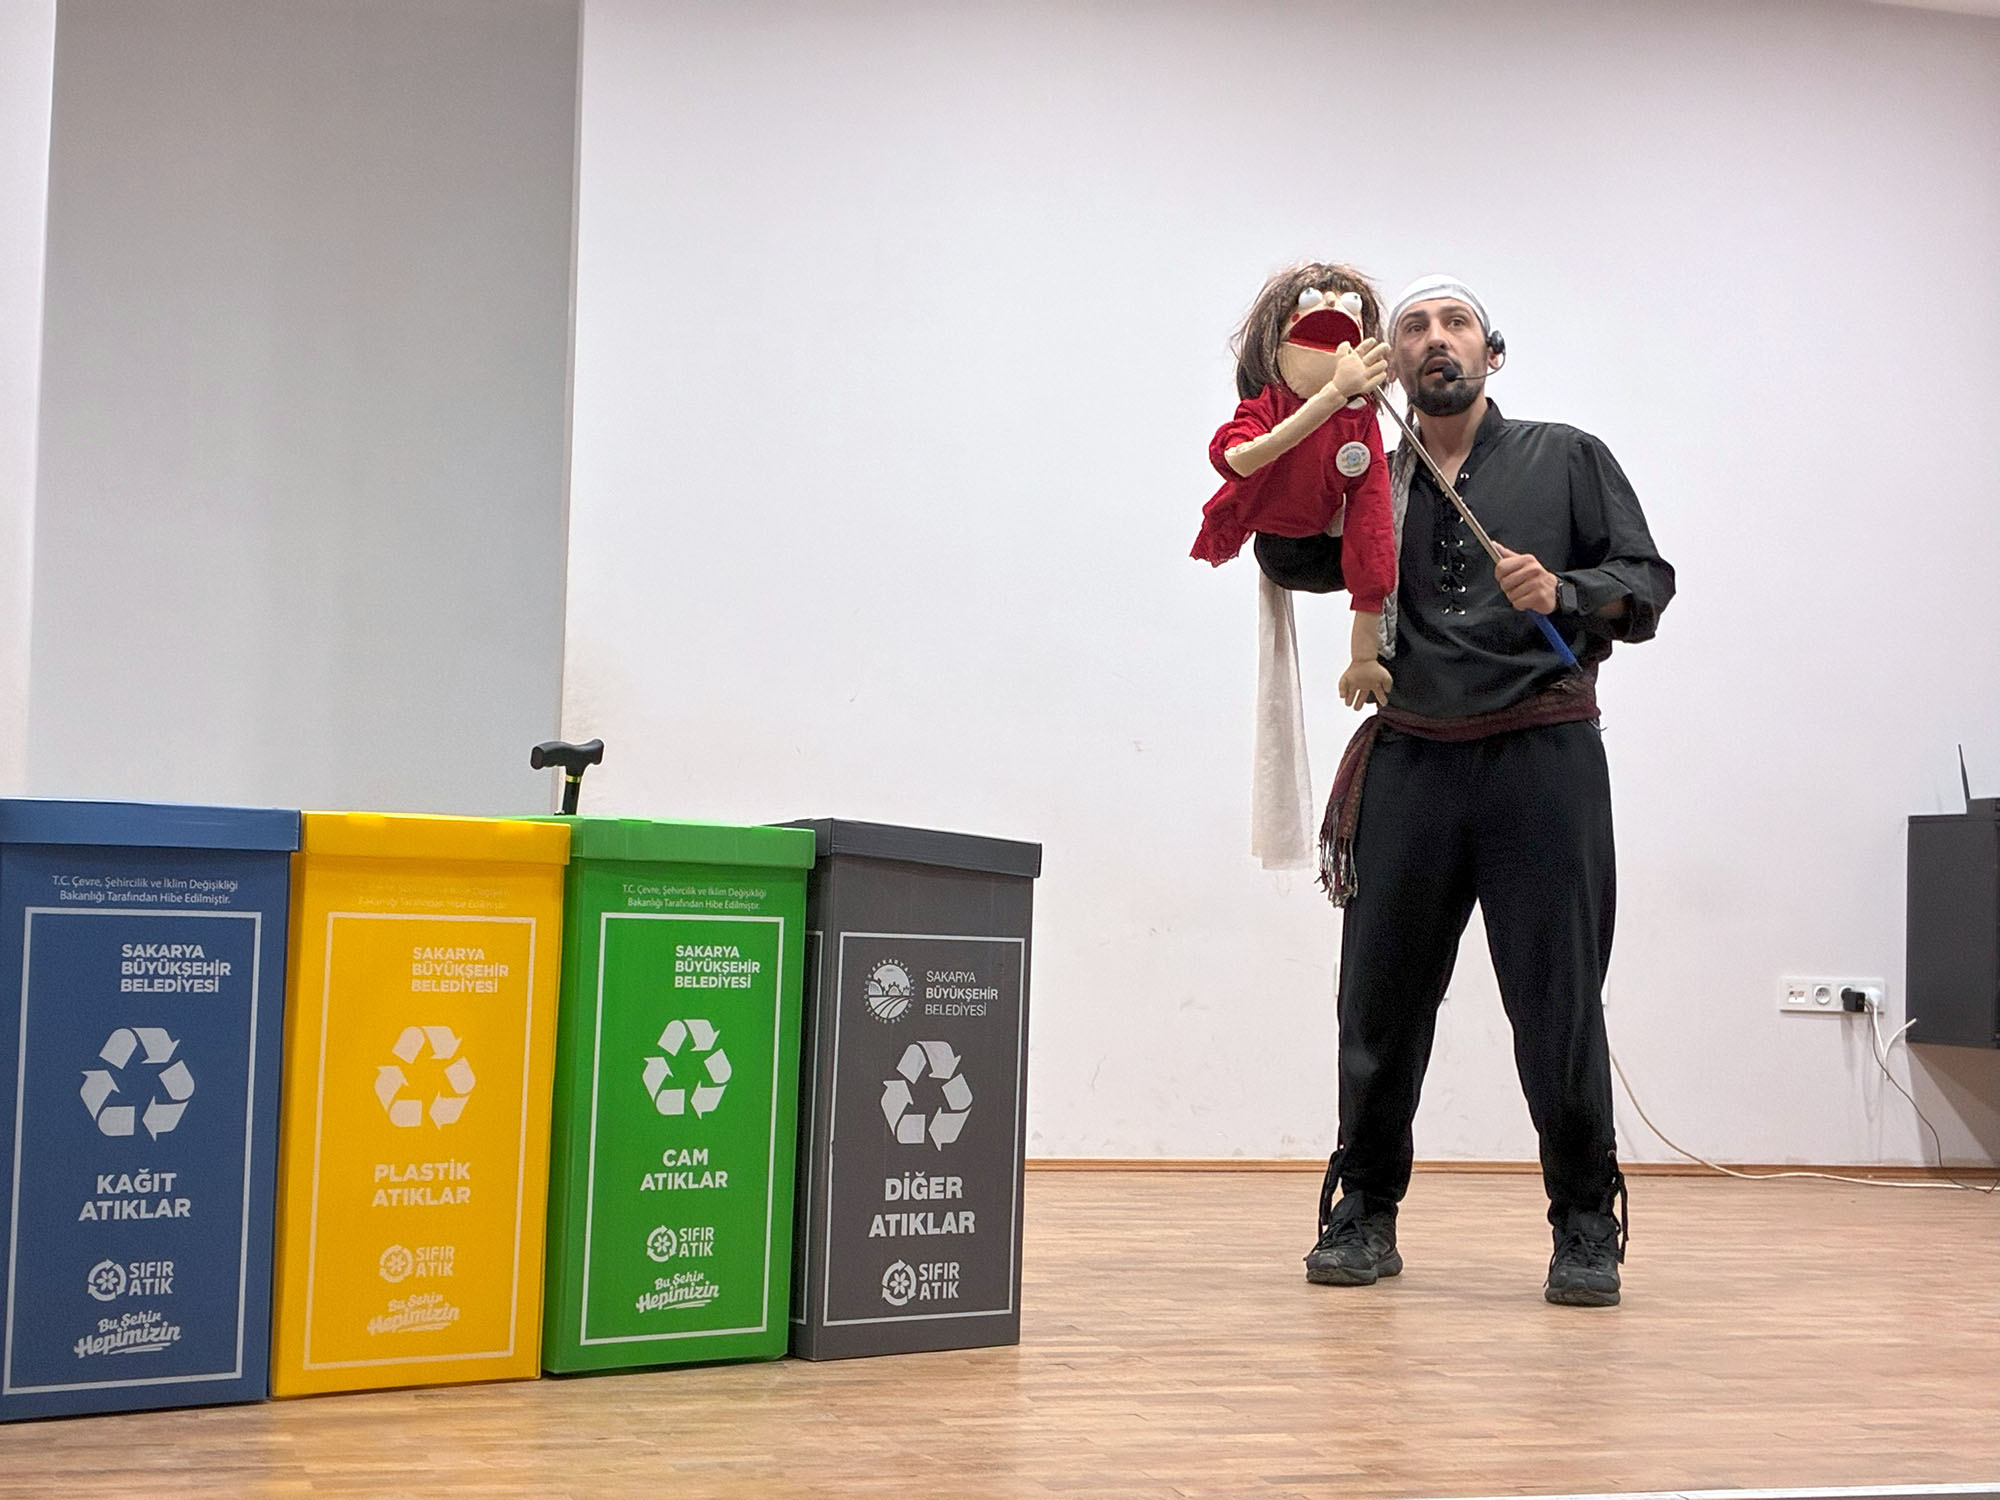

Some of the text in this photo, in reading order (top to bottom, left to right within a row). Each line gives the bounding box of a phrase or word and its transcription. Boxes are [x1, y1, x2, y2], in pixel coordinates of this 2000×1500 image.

[52, 875, 70, 887] T.C.
[104, 876, 148, 889] Şehircilik
[150, 880, 162, 888] ve
[163, 876, 187, 889] İklim
[189, 878, 239, 892] Değişikliği
[698, 888, 707, 896] ve
[59, 889, 231, 906] Bakanlığı Tarafından Hibe Edilmiştir.
[705, 899, 723, 909] Hibe
[121, 943, 205, 959] SAKARYA
[413, 946, 485, 960] SAKARYA
[675, 944, 740, 958] SAKARYA
[121, 957, 232, 977] BÜYÜKŞEHİR
[412, 960, 509, 978] BÜYÜKŞEHİR
[674, 958, 760, 976] BÜYÜKŞEHİR
[120, 975, 219, 993] BELEDİYESİ
[411, 977, 498, 993] BELEDİYESİ
[674, 974, 752, 989] BELEDİYESİ
[926, 970, 976, 983] SAKARYA
[926, 985, 998, 1002] BÜYÜKŞEHİR
[925, 1002, 987, 1017] BELEDİYESİ
[662, 1148, 708, 1168] CAM
[374, 1159, 471, 1183] PLASTİK
[97, 1168, 177, 1194] KAĞIT
[640, 1170, 728, 1191] ATIKLAR
[885, 1171, 963, 1201] DİĞER
[372, 1186, 471, 1208] ATIKLAR
[78, 1198, 191, 1222] ATIKLAR
[679, 1226, 714, 1241] SIFIR
[868, 1211, 975, 1238] ATIKLAR
[415, 1245, 454, 1261] SIFIR
[678, 1241, 713, 1257] ATIK
[129, 1260, 174, 1278] SIFIR
[415, 1261, 453, 1277] ATIK
[919, 1261, 960, 1281] SIFIR
[128, 1278, 173, 1296] ATIK
[654, 1270, 704, 1290] Bu Şehir
[636, 1283, 720, 1314] Hepimizin
[919, 1281, 960, 1301] ATIK
[98, 1310, 161, 1332] Bu Şehir
[366, 1303, 460, 1336] Hepimizin
[73, 1322, 182, 1358] Hepimizin
